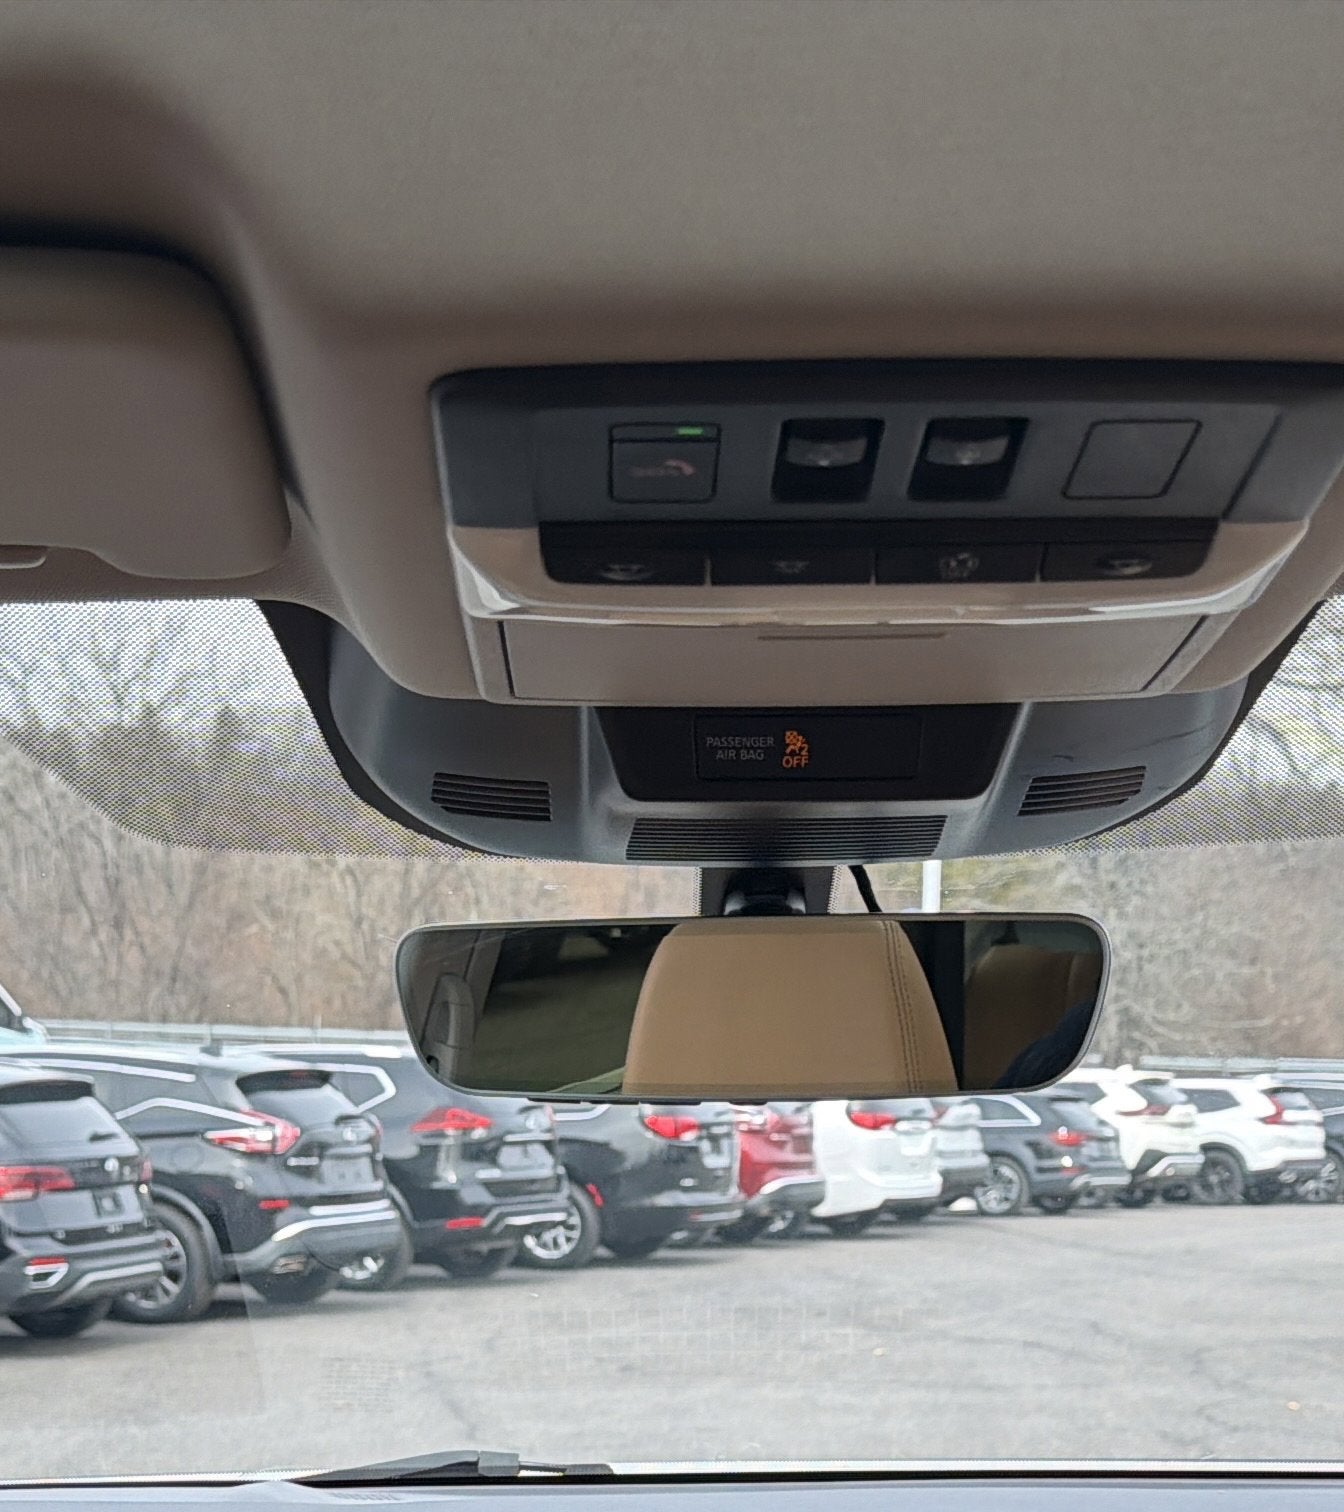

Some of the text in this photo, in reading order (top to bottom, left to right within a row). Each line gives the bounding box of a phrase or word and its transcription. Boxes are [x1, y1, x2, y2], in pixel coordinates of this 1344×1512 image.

[706, 737, 775, 748] PASSENGER
[716, 749, 765, 760] AIR BAG
[782, 756, 809, 768] OFF
